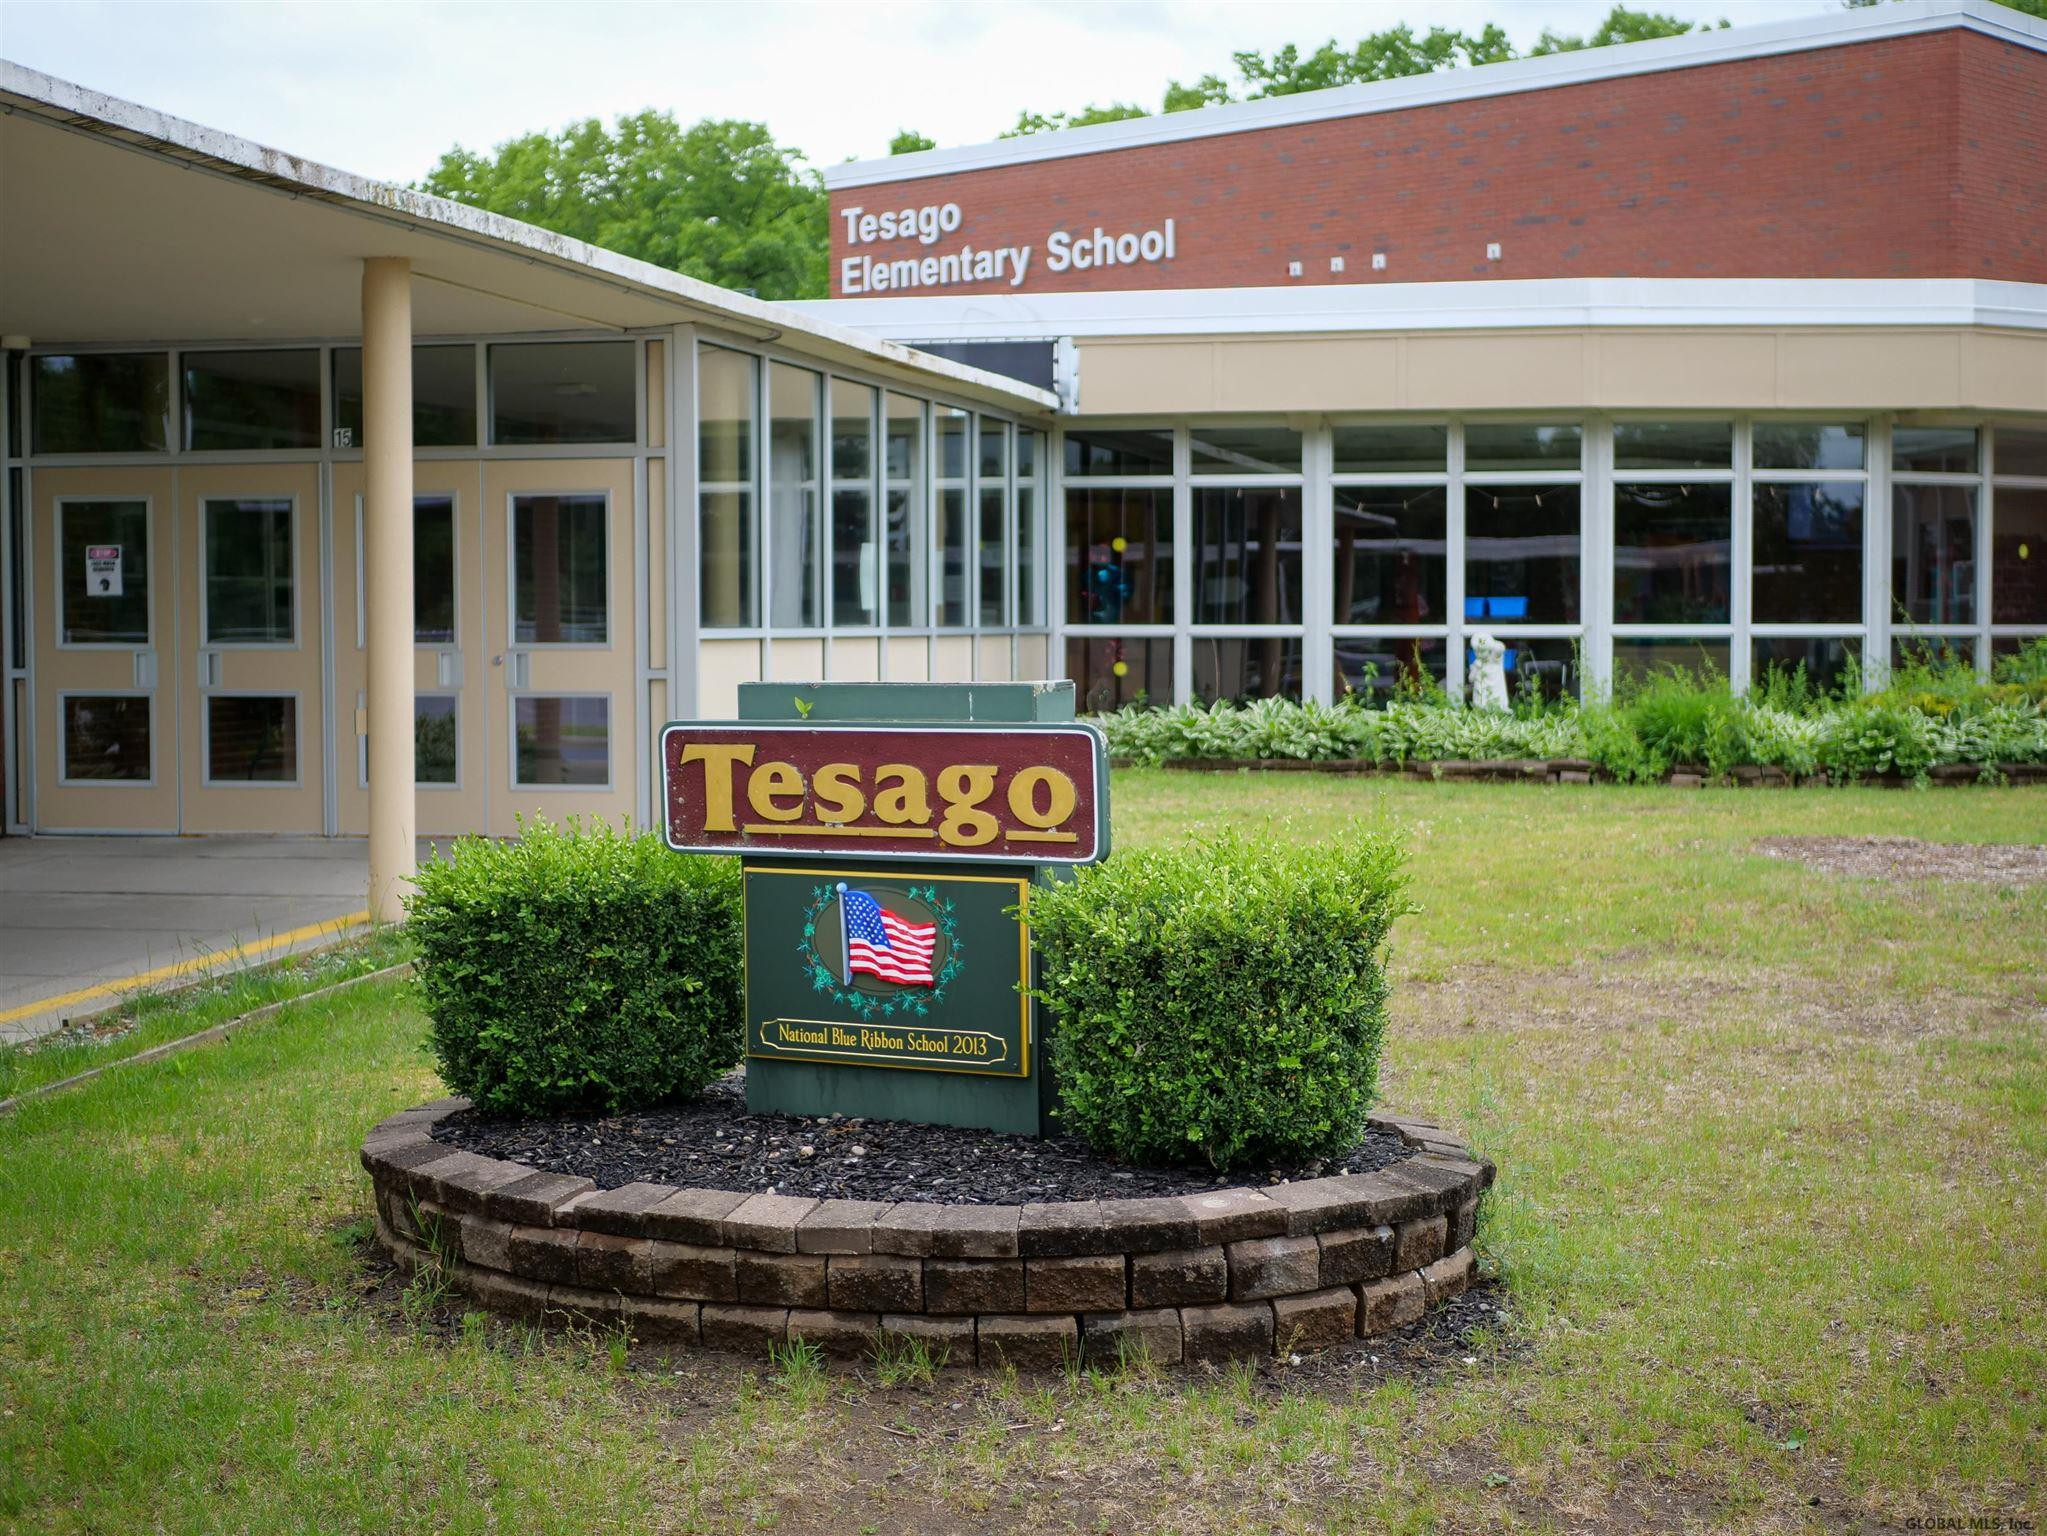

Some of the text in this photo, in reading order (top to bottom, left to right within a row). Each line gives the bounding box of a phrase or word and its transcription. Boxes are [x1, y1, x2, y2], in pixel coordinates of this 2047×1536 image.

[841, 203, 962, 246] Tesago
[841, 218, 1175, 294] Elementary School
[335, 429, 351, 447] 15
[680, 743, 1077, 847] Tesago
[778, 1023, 987, 1056] National Blue Ribbon School 2013
